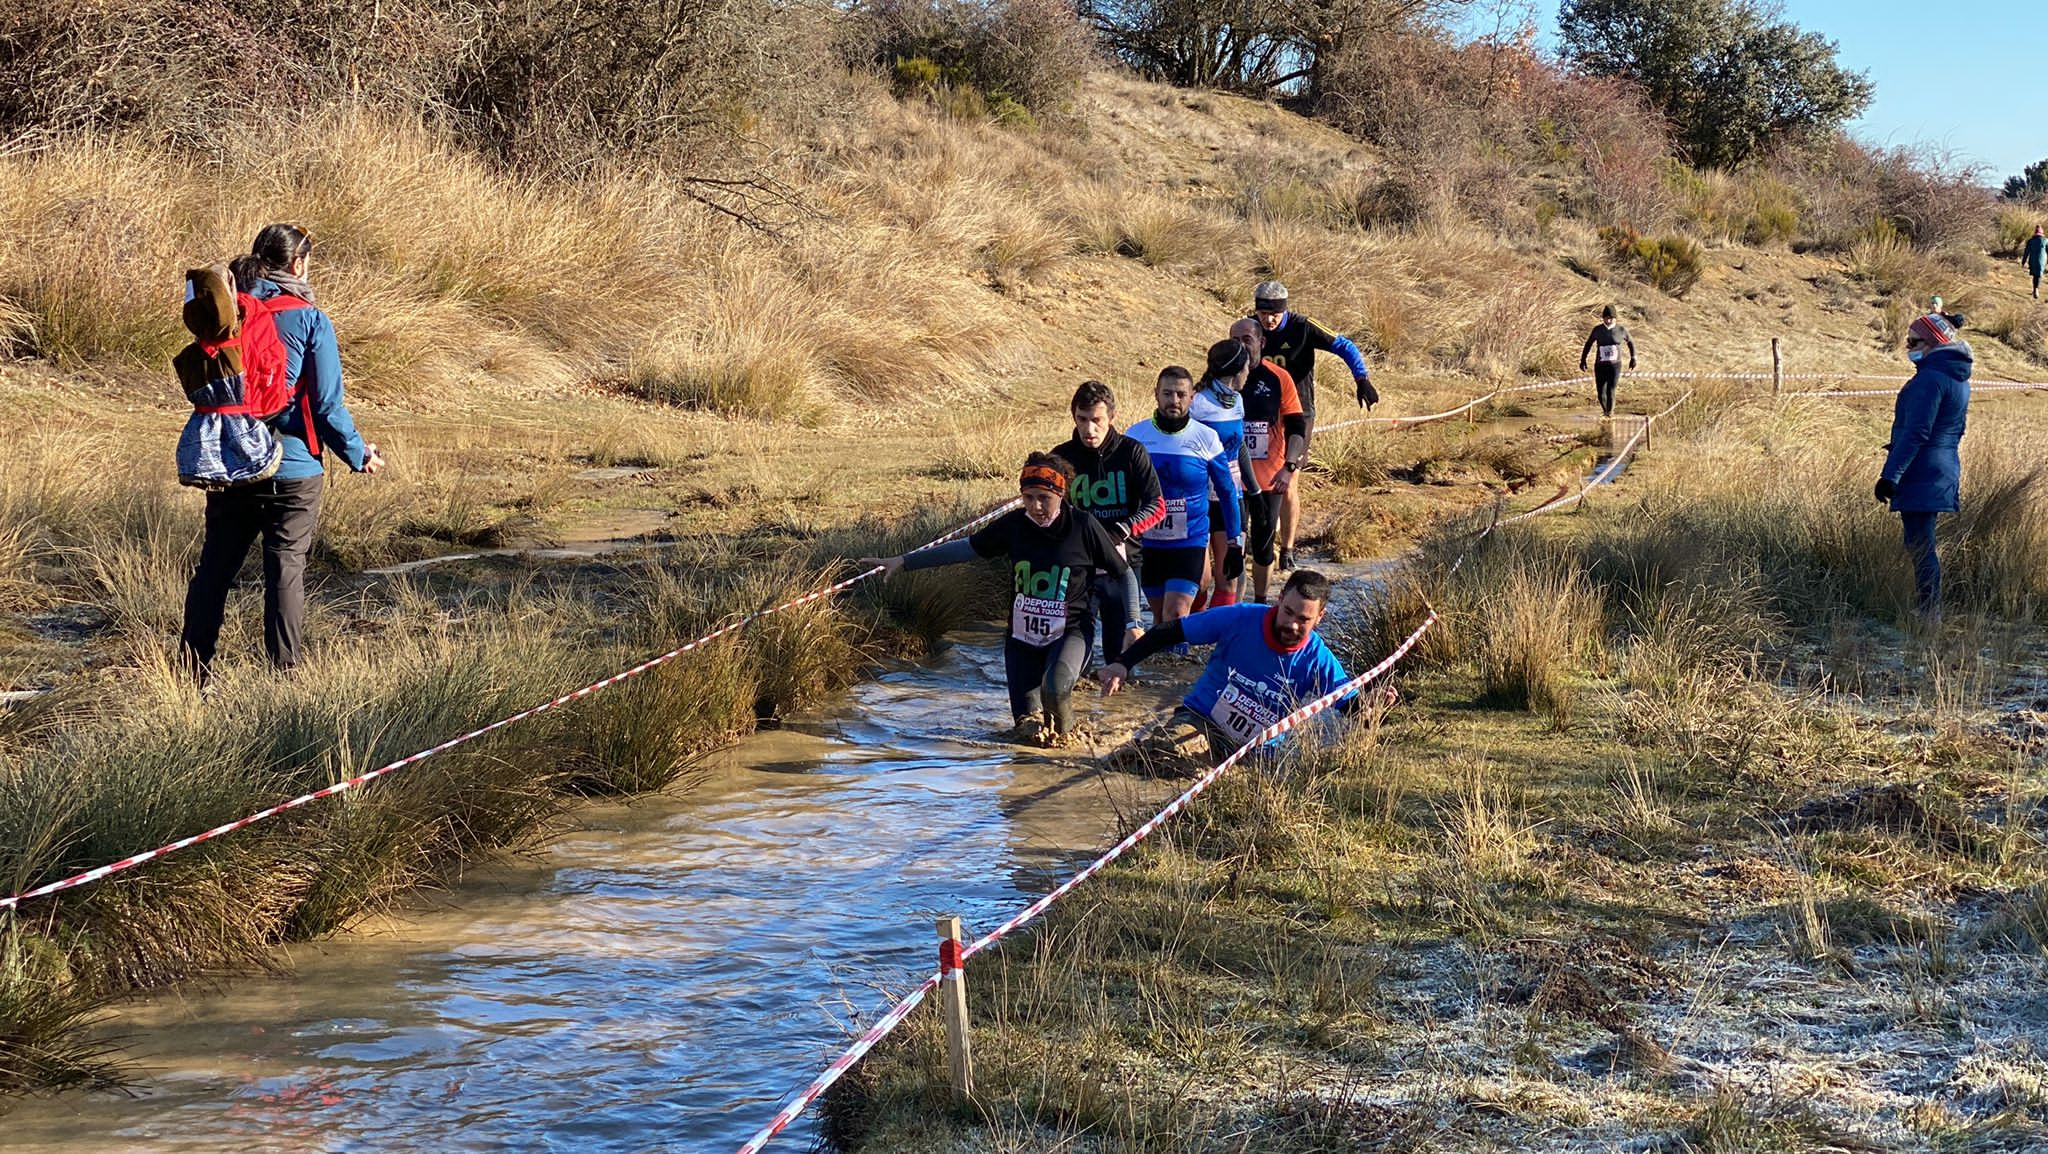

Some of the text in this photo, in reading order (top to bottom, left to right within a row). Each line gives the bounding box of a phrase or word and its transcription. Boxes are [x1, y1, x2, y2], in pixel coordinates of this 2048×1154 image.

[1093, 507, 1128, 519] harma
[1154, 514, 1174, 530] 74
[1023, 605, 1065, 617] PARA TODOS
[1024, 597, 1065, 610] DEPORTE
[1023, 615, 1051, 636] 145
[1234, 701, 1252, 715] PARA
[1237, 694, 1279, 724] DEPORTE
[1226, 710, 1256, 738] 101
